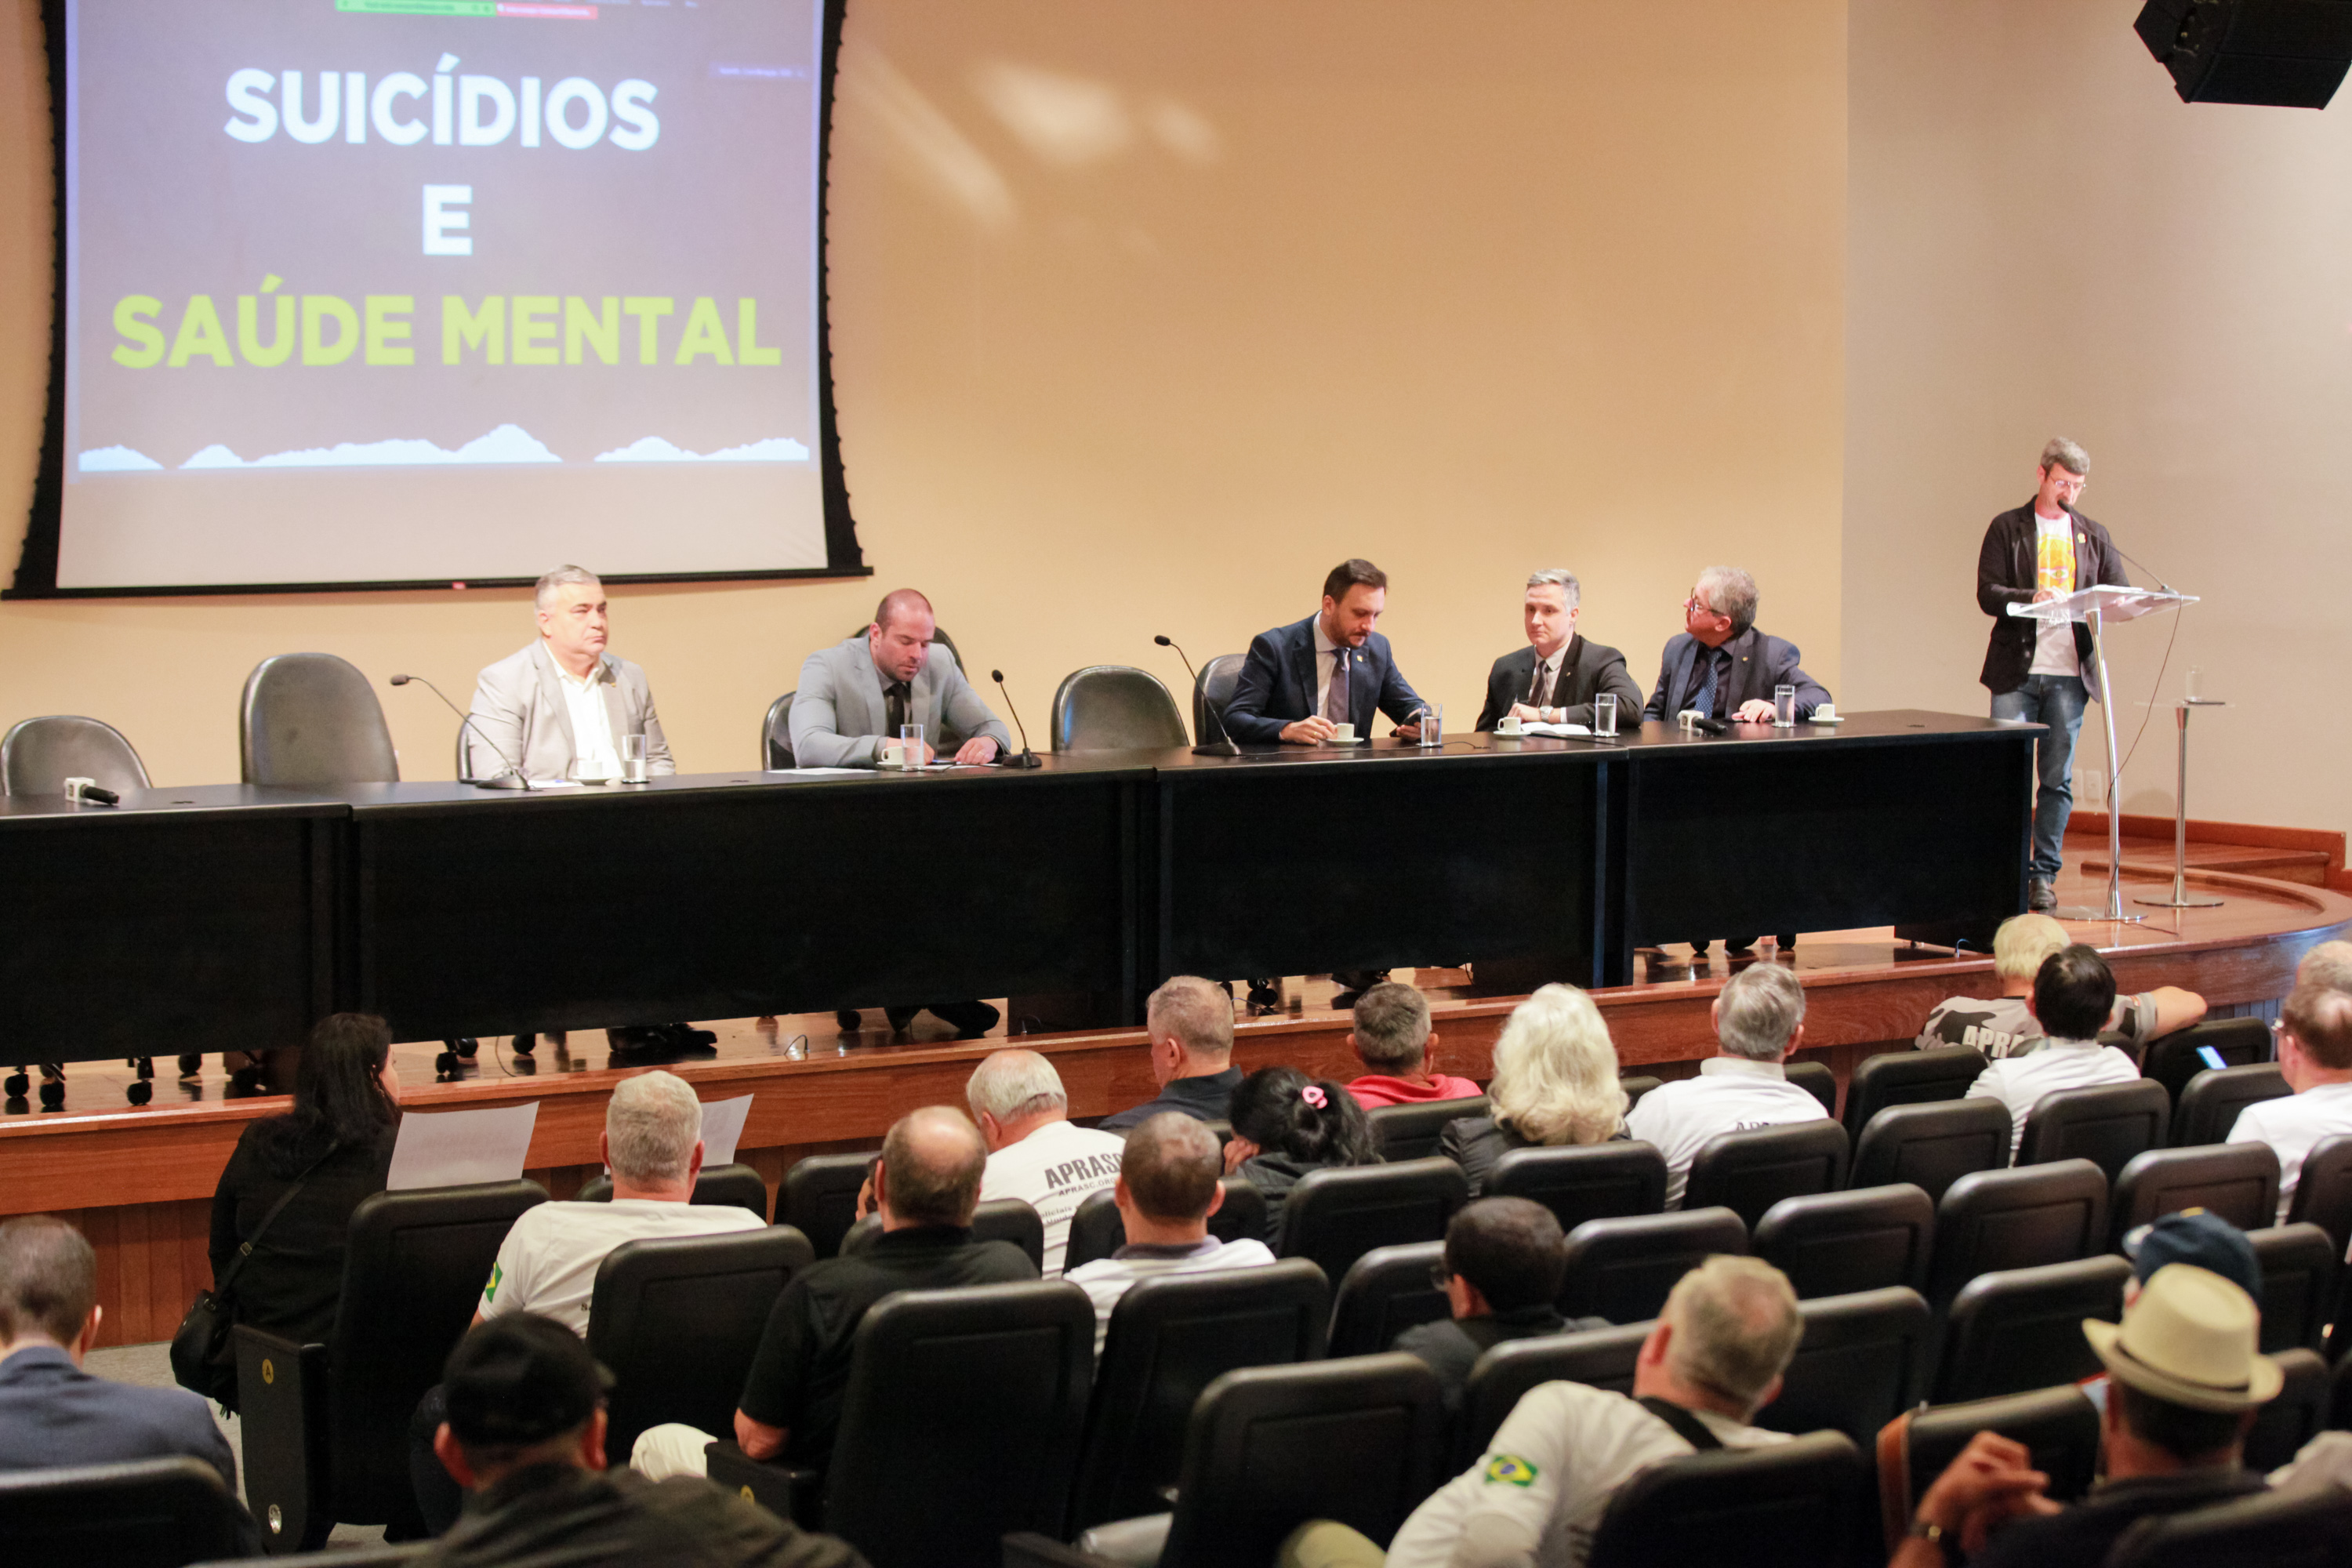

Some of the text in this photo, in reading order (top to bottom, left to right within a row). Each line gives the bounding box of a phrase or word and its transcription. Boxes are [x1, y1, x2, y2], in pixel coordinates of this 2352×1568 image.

[223, 53, 660, 151] SUICÍDIOS
[423, 184, 472, 256] E
[111, 273, 782, 369] SAÚDE MENTAL
